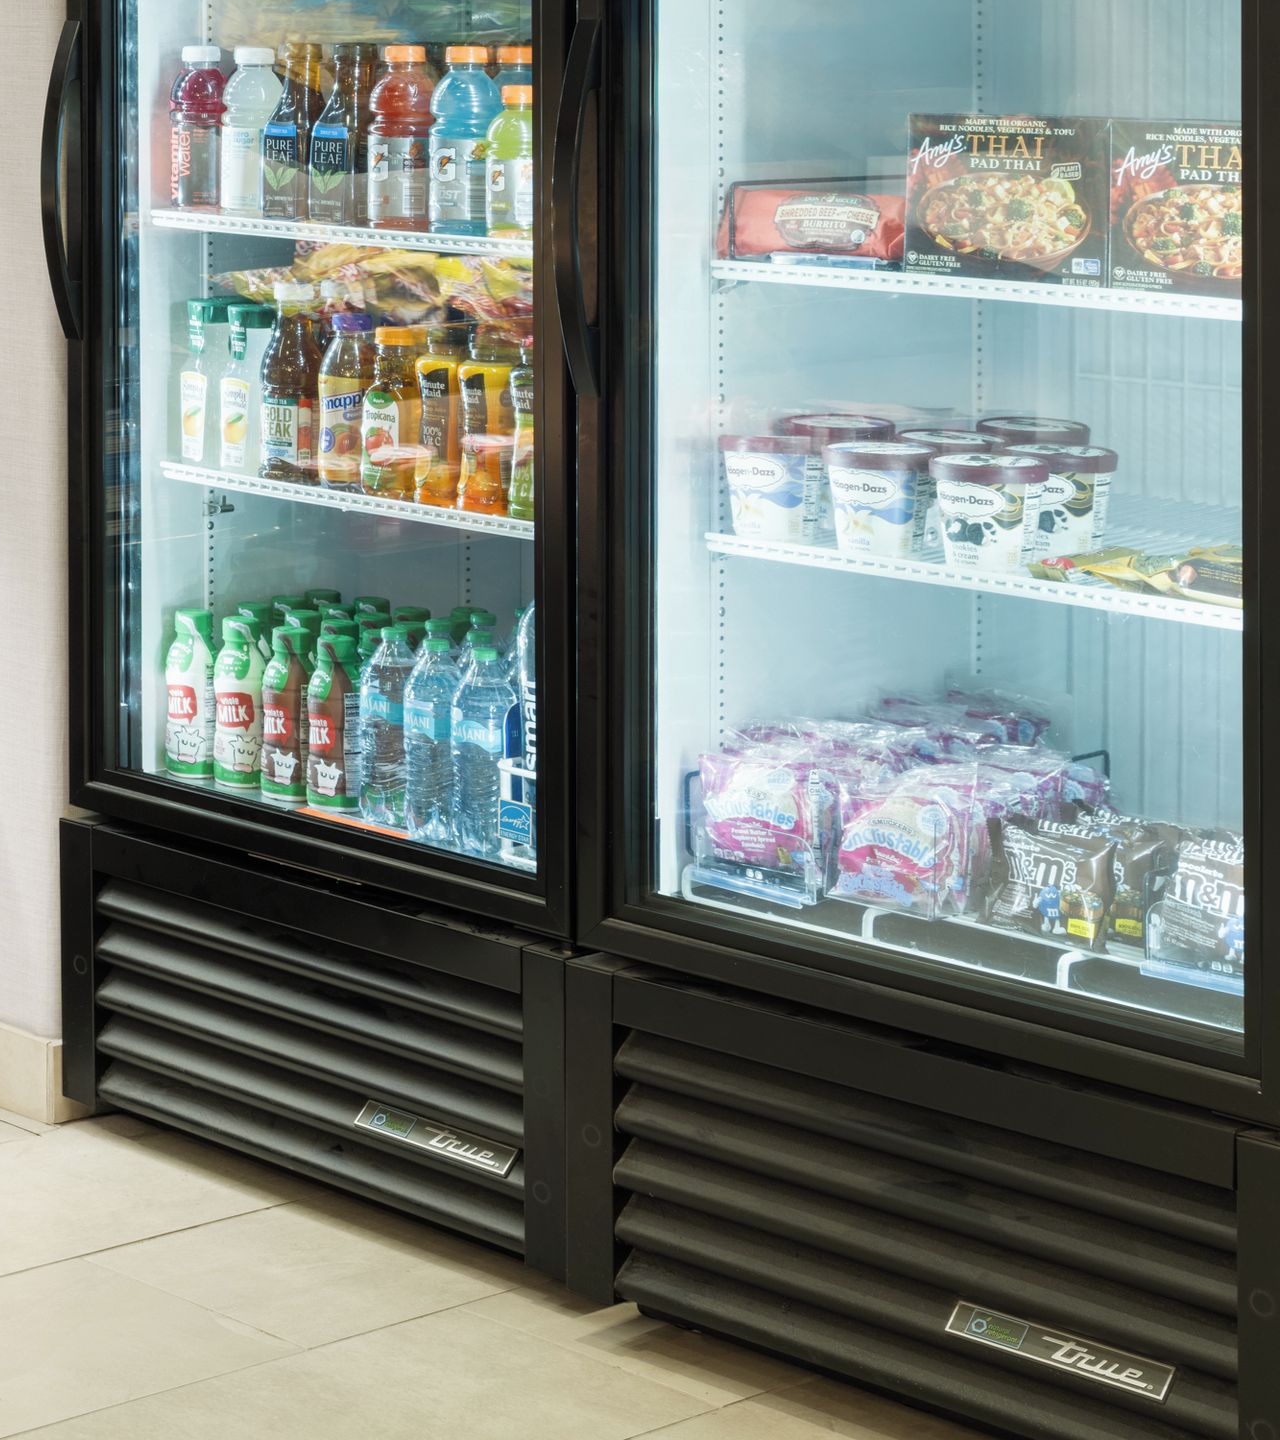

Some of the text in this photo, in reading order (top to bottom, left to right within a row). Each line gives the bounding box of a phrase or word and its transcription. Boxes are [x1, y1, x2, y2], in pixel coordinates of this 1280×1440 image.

[266, 138, 294, 151] PURE
[314, 140, 343, 153] PURE
[266, 150, 294, 162] LEAF
[314, 152, 343, 165] LEAF
[911, 133, 1044, 174] Amy's THAI
[970, 157, 1042, 172] PAD THAI
[217, 703, 249, 723] MILK
[1042, 1335, 1148, 1388] true
